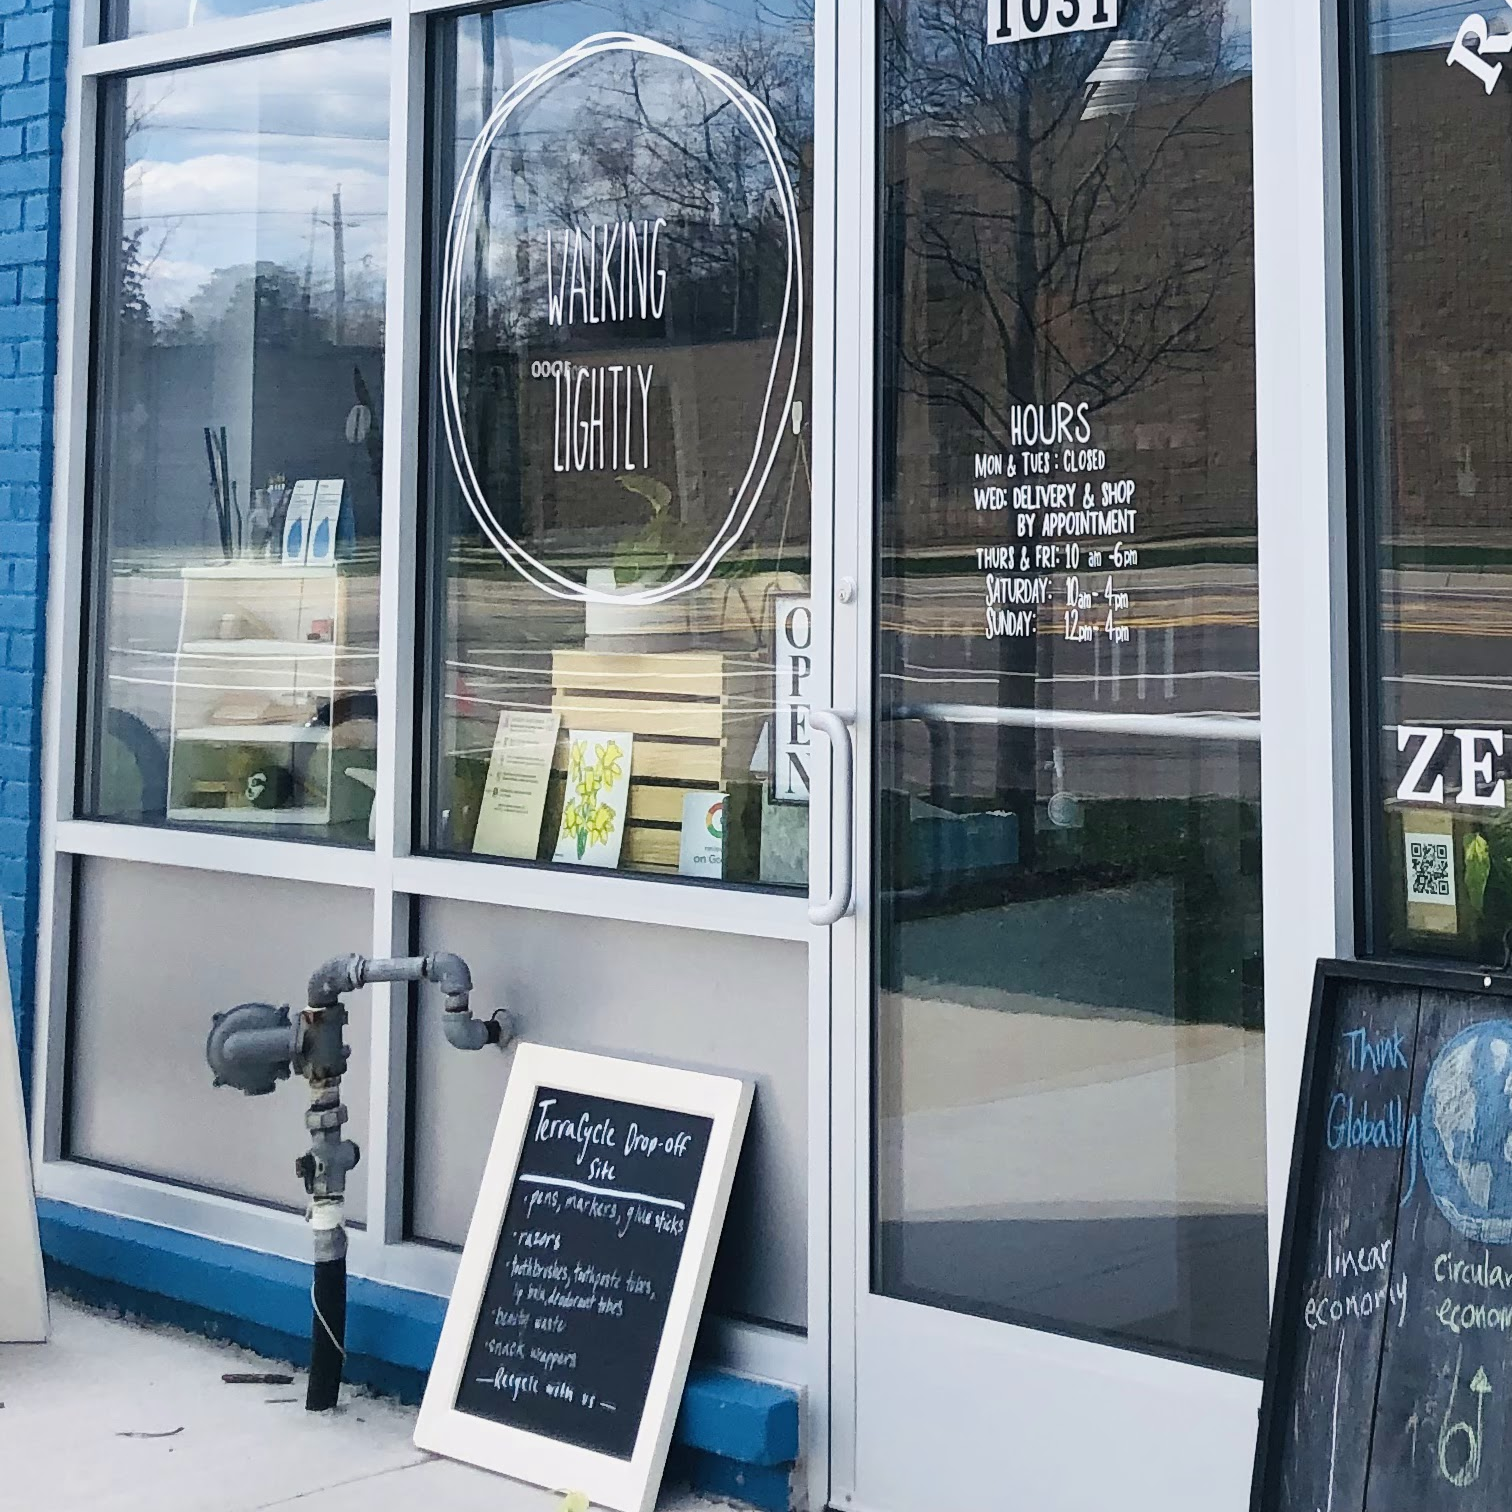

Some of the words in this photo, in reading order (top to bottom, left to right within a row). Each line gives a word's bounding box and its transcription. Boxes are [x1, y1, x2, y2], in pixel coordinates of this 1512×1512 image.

[547, 218, 666, 326] WALKING
[554, 364, 653, 471] LIGHTLY
[1011, 401, 1091, 446] HOURS
[974, 453, 1002, 479] MON
[1007, 454, 1017, 478] &
[1063, 449, 1106, 473] CLOSED
[974, 487, 1008, 511] WED:
[1013, 483, 1077, 510] DELIVERY
[1083, 482, 1095, 509] &
[1101, 480, 1136, 506] SHOP
[1017, 513, 1037, 537] BY
[1041, 509, 1138, 537] APPOINTMENT
[976, 545, 1015, 570] THURS
[1020, 546, 1030, 571] &
[1036, 544, 1060, 569] FRI:
[1065, 543, 1080, 569] 10
[1088, 550, 1102, 567] am
[985, 573, 1052, 607] SATURDAY:
[985, 607, 1037, 640] SUNDAY:
[784, 606, 812, 794] OPEN
[1343, 1026, 1407, 1075] Think
[624, 1123, 691, 1157] Drop-off
[1326, 1091, 1418, 1207] Globally
[587, 1158, 616, 1180] Site
[527, 1189, 561, 1219] pens,
[565, 1195, 622, 1225] markers,
[655, 1211, 685, 1236] sticks
[518, 1231, 561, 1250] razors
[1326, 1229, 1392, 1279] linear
[1304, 1273, 1407, 1330] economy
